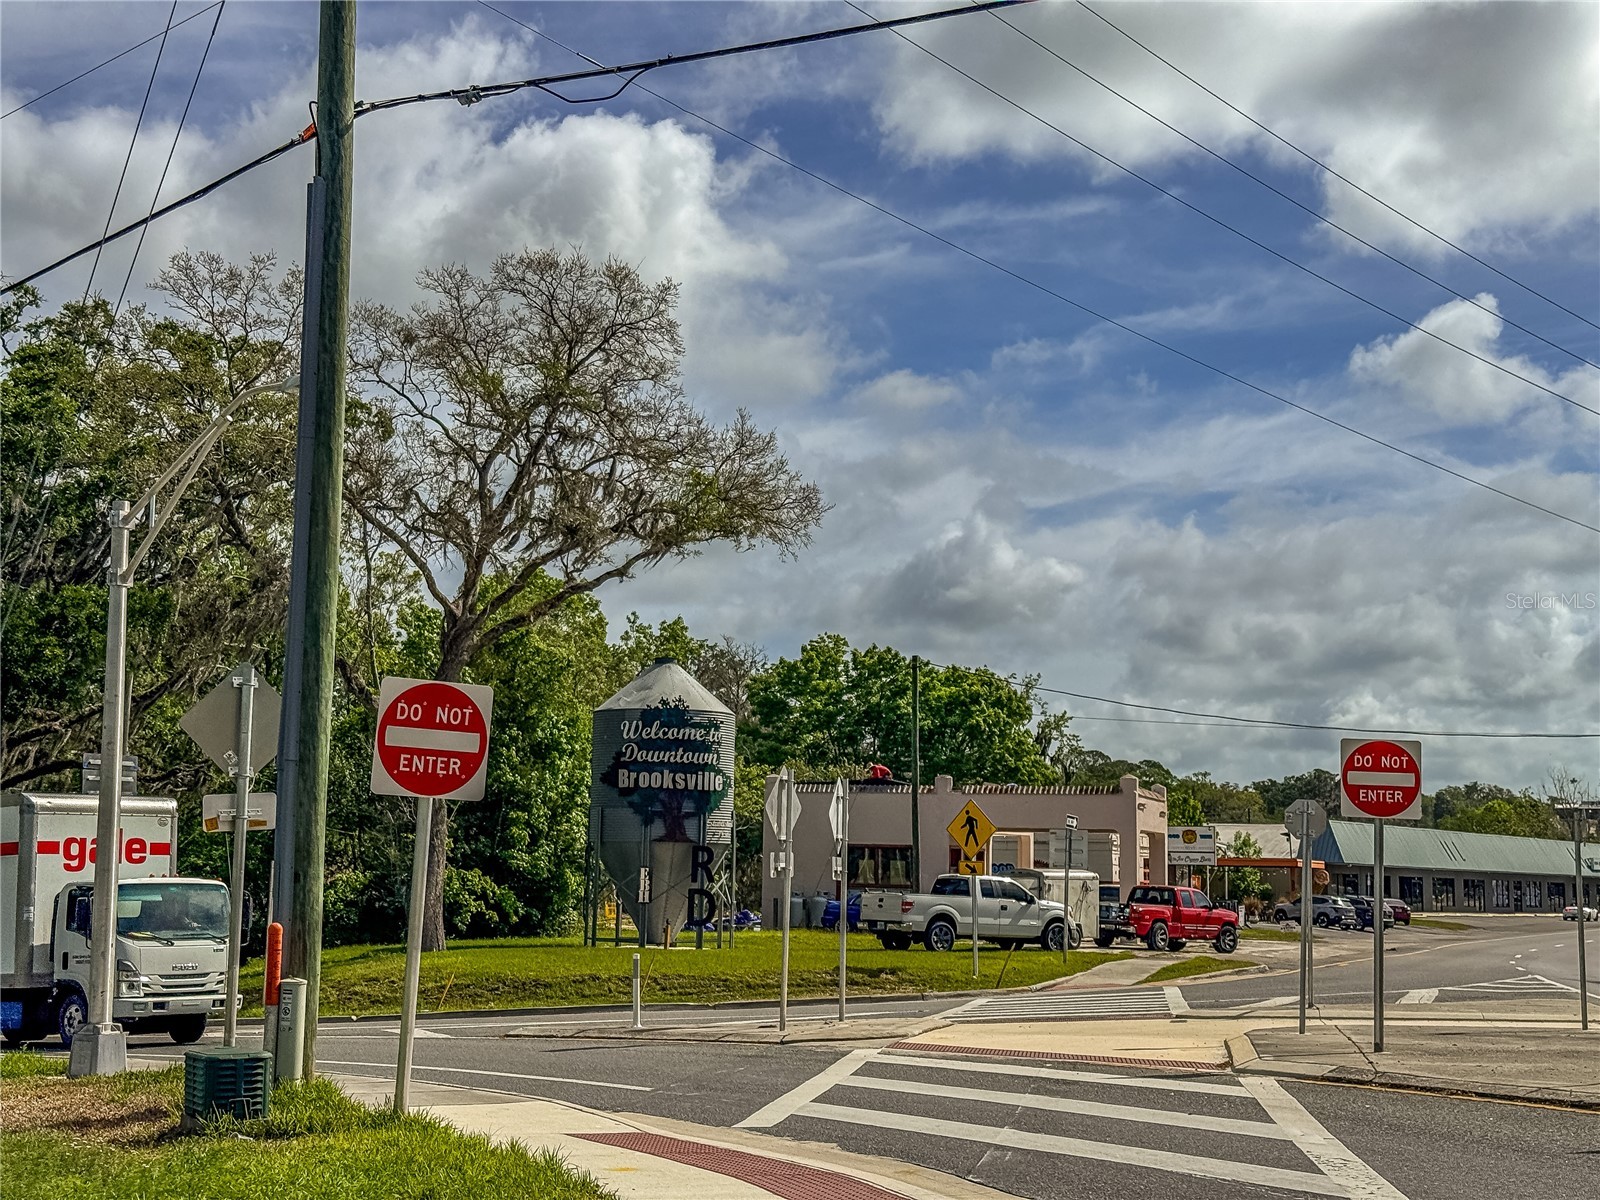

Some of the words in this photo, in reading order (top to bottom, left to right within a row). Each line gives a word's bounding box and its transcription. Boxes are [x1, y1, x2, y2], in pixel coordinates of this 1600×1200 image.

[396, 702, 422, 721] DO
[435, 706, 473, 726] NOT
[620, 720, 707, 740] Welcome
[708, 727, 722, 742] to
[399, 753, 461, 776] ENTER
[620, 742, 719, 765] Downtown
[1354, 755, 1373, 767] DO
[1381, 756, 1409, 769] NOT
[618, 768, 724, 791] Brooksville
[1359, 788, 1403, 803] ENTER
[171, 961, 200, 972] ISUZU
